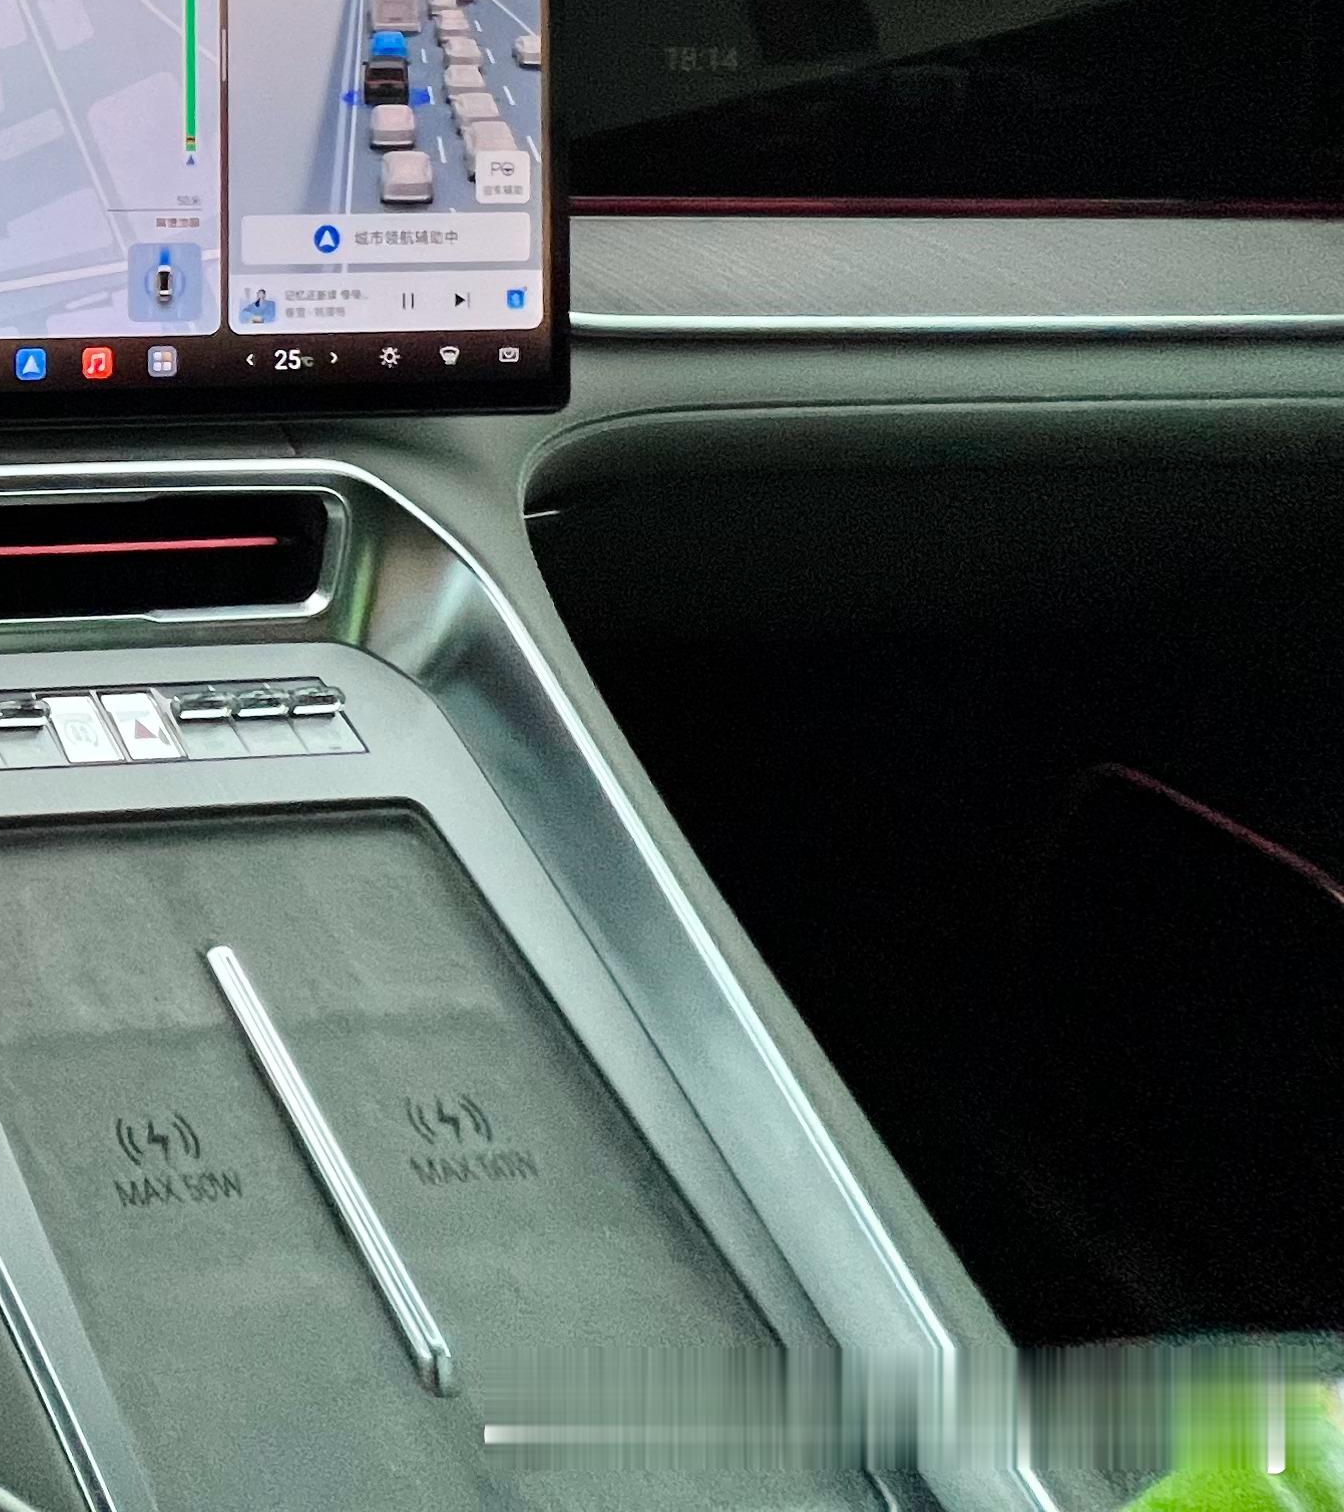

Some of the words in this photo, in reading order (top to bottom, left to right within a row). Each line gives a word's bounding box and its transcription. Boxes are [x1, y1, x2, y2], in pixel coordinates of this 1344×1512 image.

[411, 1155, 470, 1186] MAX
[114, 1174, 177, 1208] MAX
[184, 1170, 244, 1203] 50W
